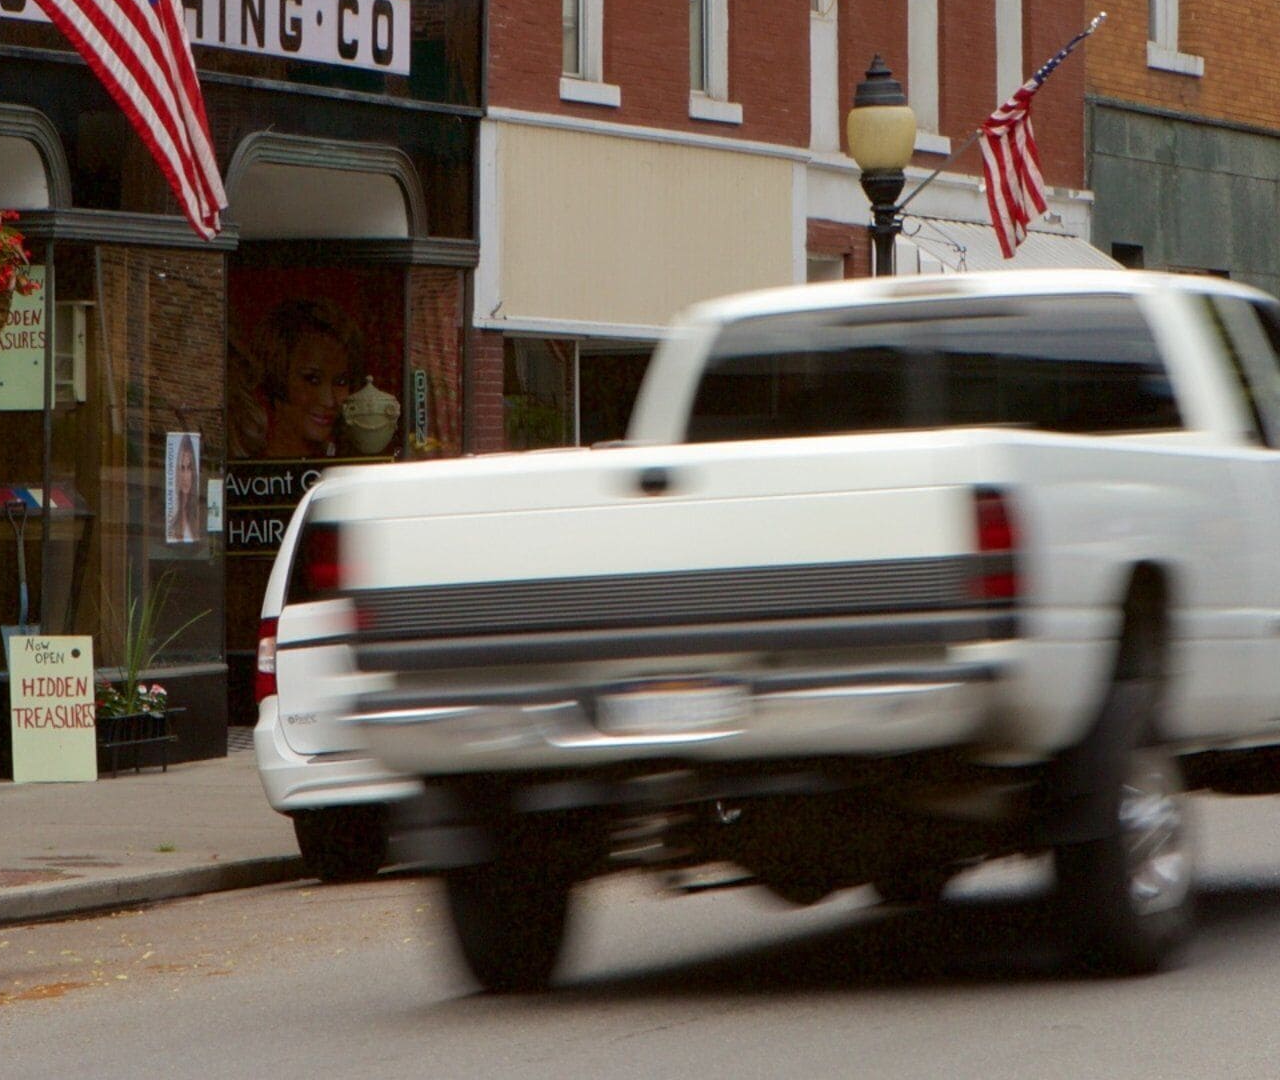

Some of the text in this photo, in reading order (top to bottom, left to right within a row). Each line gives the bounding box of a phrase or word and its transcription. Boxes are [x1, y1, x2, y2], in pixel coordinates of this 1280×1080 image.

[225, 470, 293, 496] Avant
[229, 519, 284, 544] HAIR
[35, 652, 65, 665] OPEN
[21, 676, 88, 698] HIDDEN
[12, 702, 96, 730] TREASURES
